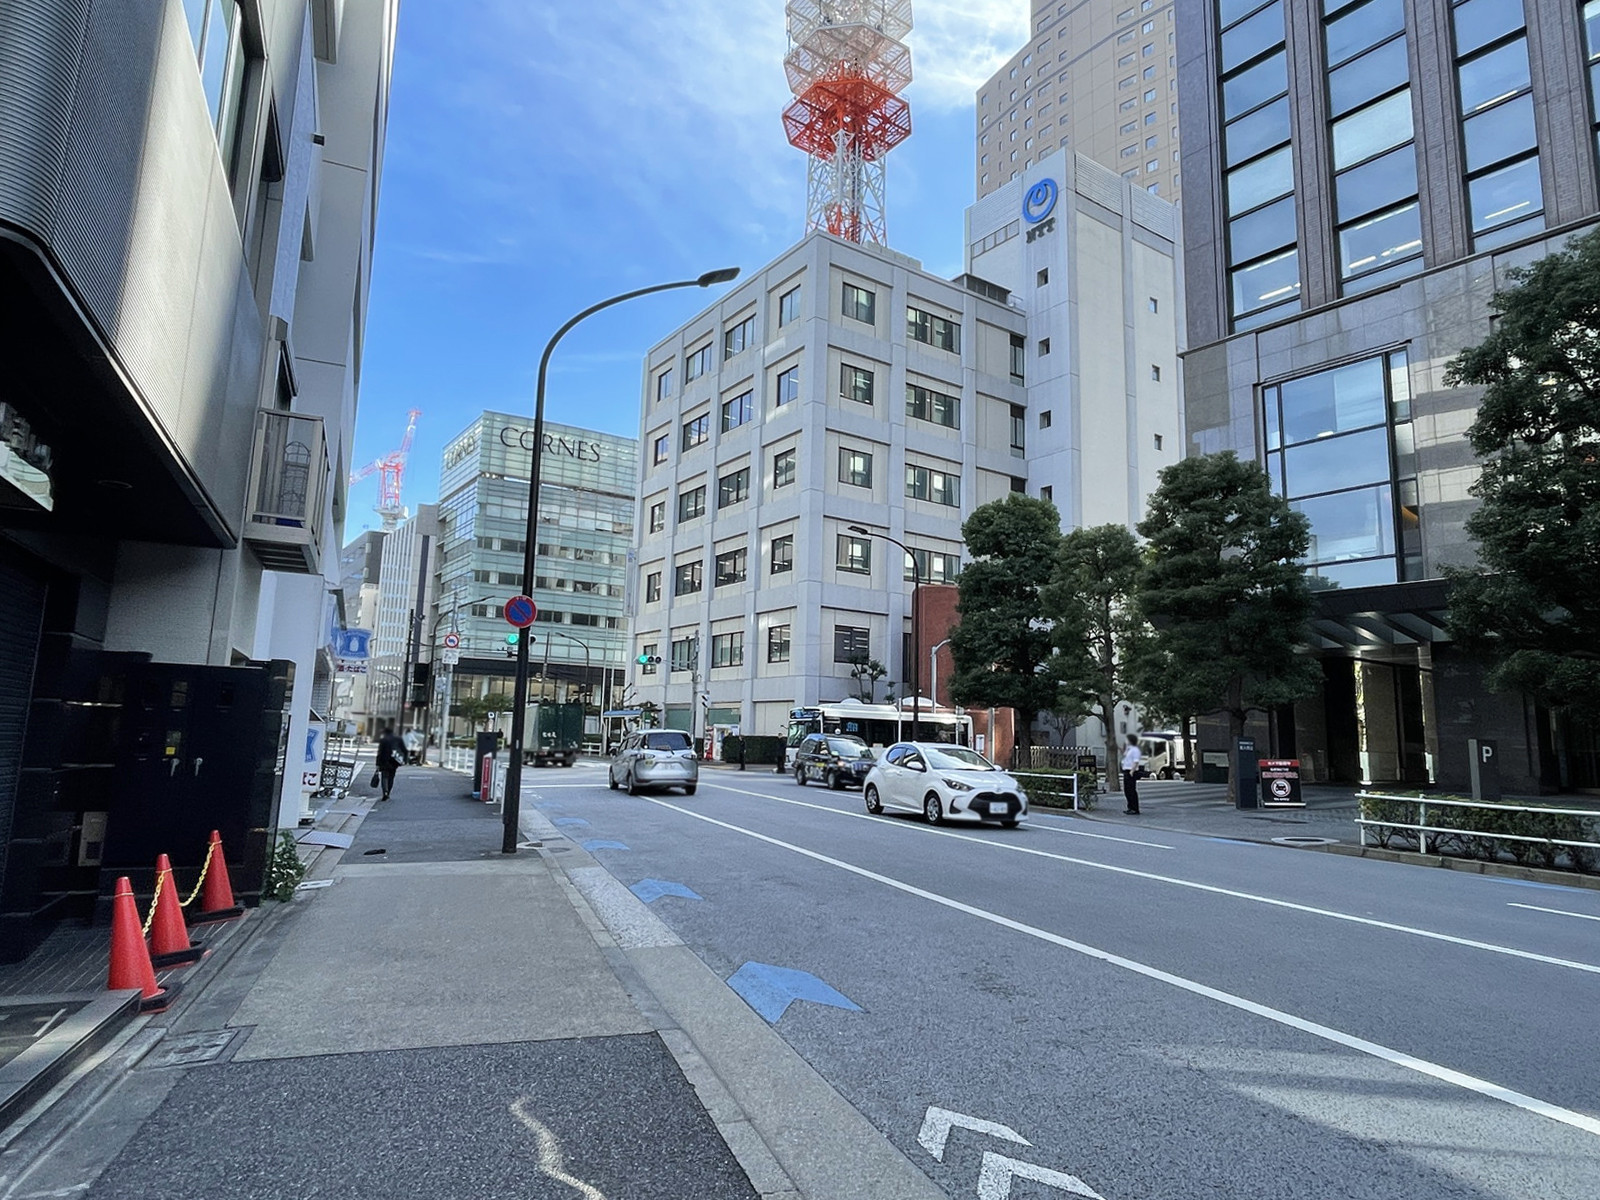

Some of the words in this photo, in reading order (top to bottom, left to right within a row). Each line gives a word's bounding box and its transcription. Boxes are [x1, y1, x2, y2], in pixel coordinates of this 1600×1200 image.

[1026, 217, 1056, 244] NTT
[499, 426, 601, 463] CORNES
[1482, 746, 1493, 763] P
